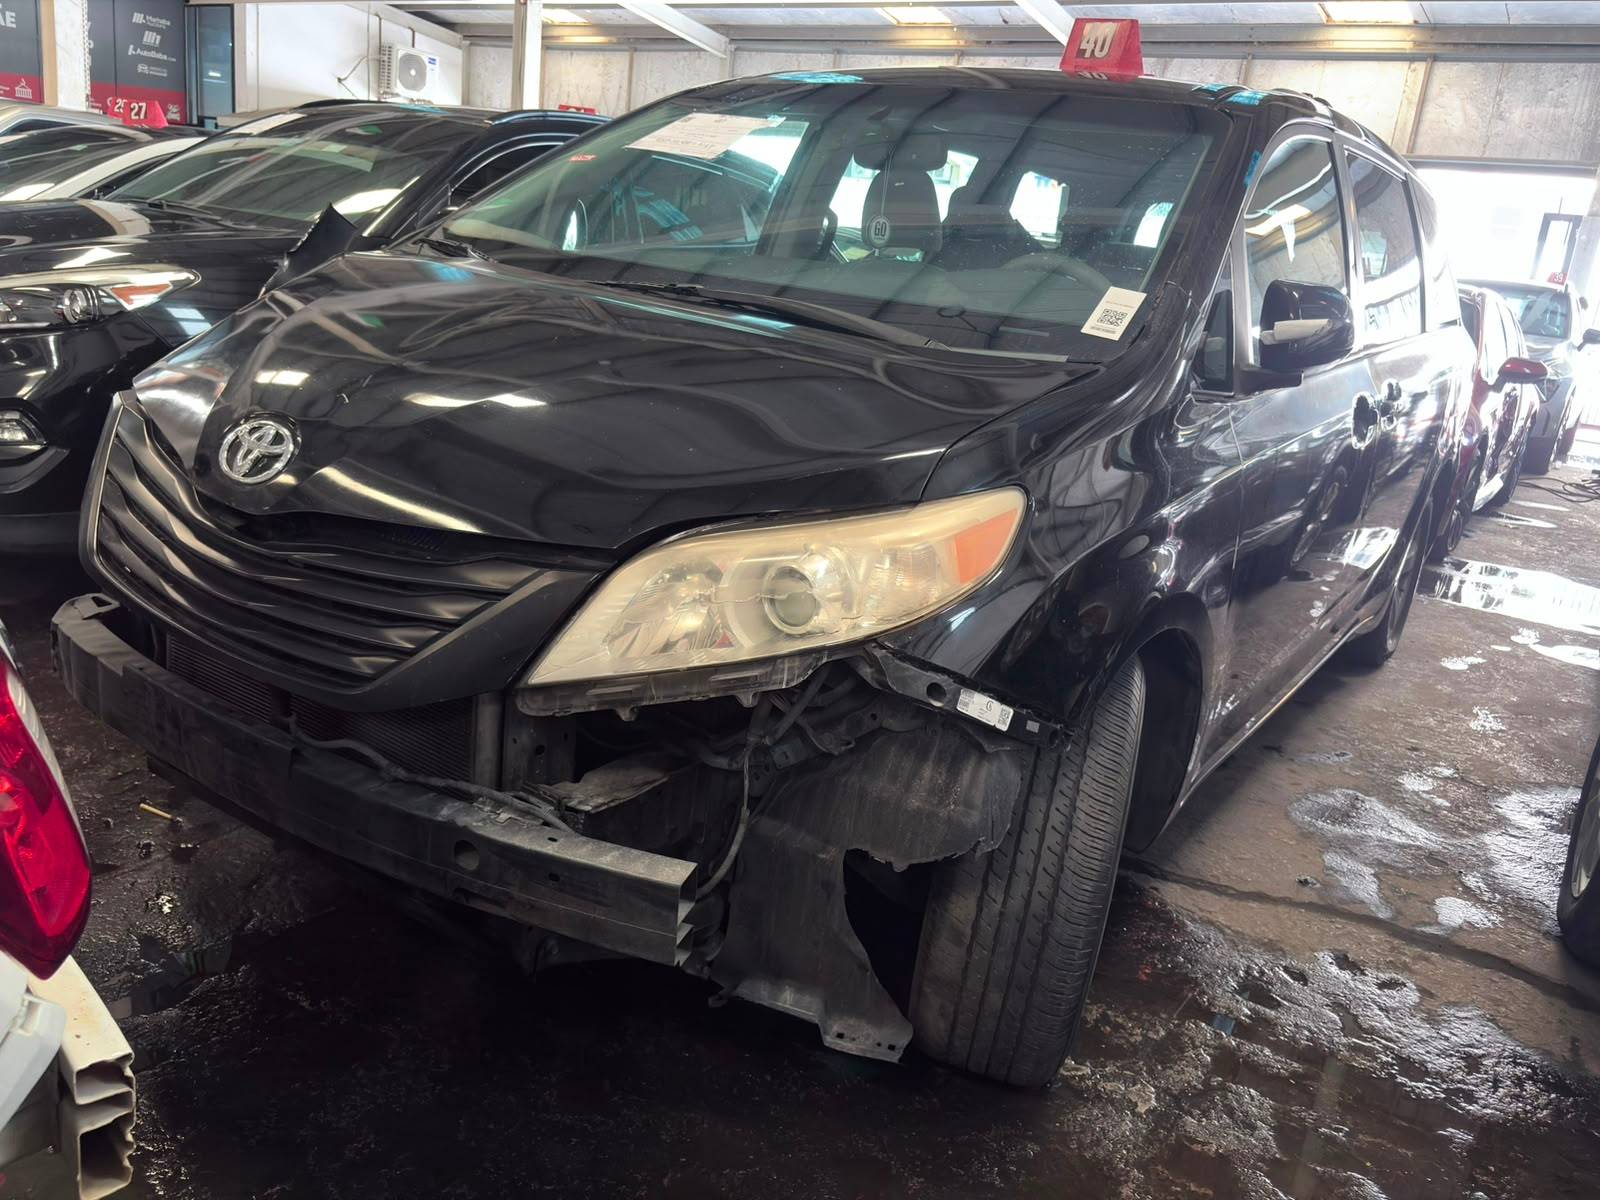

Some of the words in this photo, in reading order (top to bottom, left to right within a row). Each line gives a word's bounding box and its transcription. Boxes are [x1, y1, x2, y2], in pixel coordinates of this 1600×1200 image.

[1080, 22, 1118, 58] 40
[130, 102, 148, 120] 27
[875, 221, 887, 237] GO
